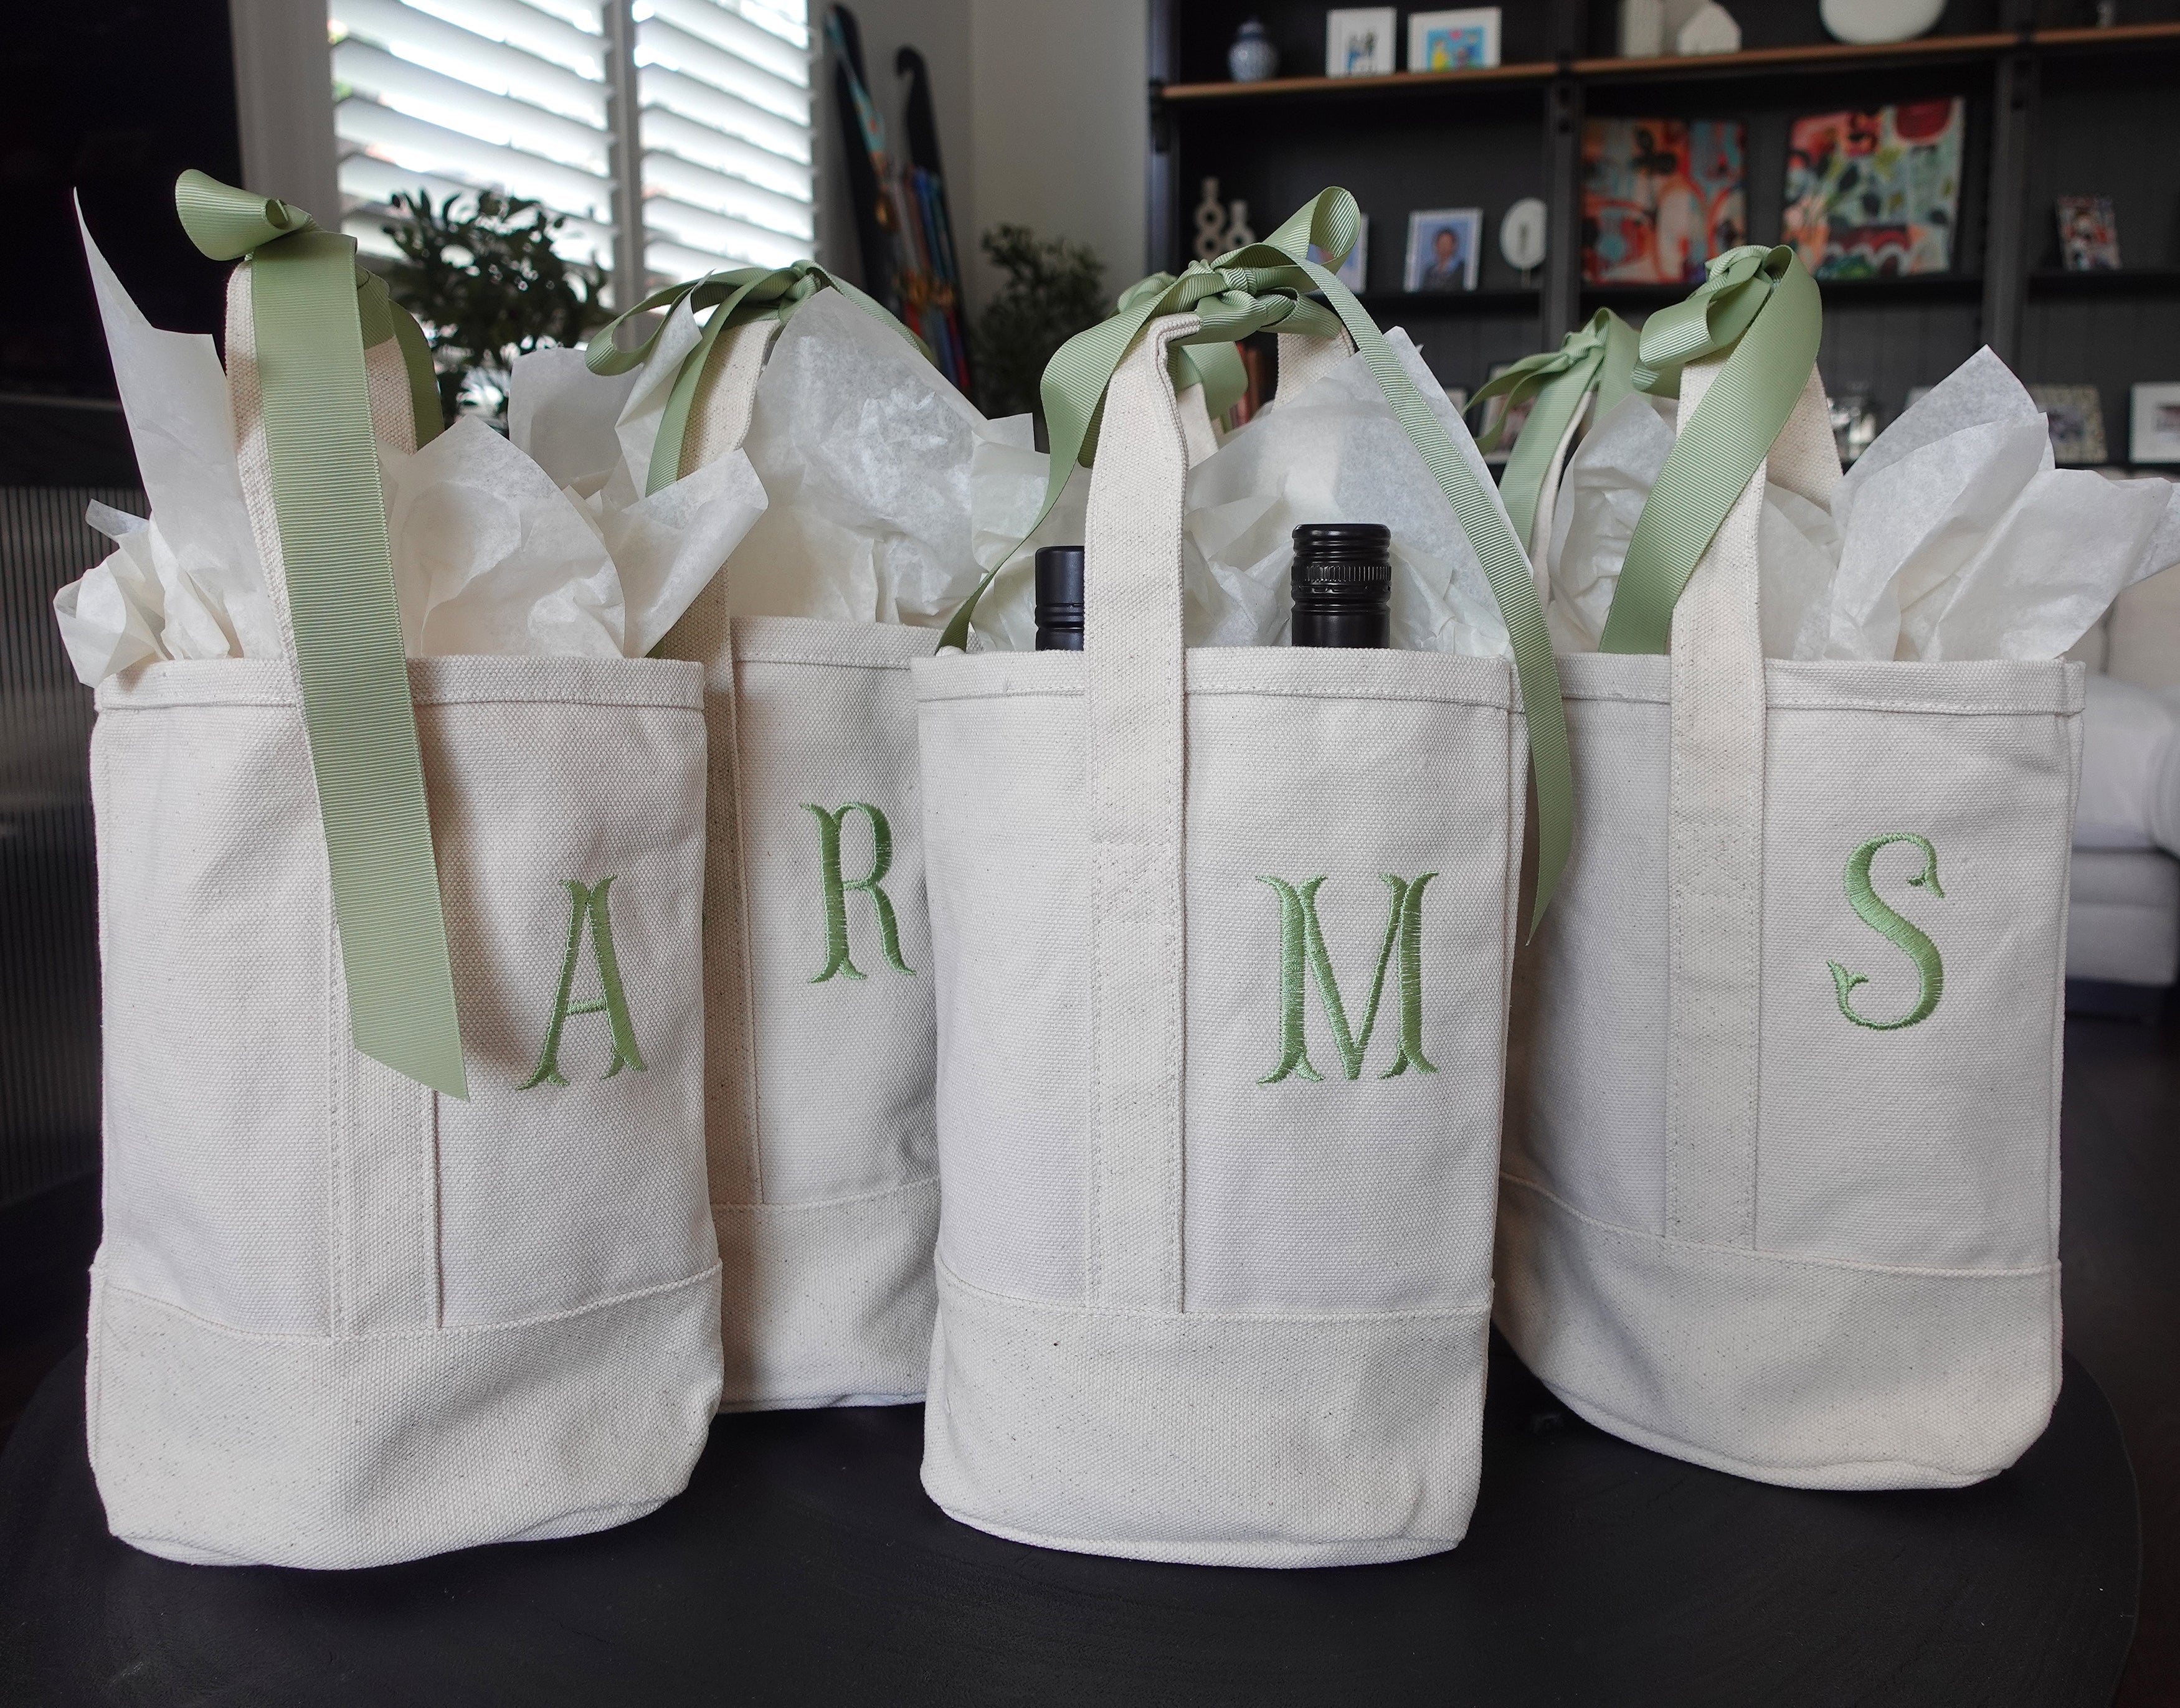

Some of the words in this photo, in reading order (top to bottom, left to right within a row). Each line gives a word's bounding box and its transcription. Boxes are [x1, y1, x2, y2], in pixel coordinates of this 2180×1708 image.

[517, 875, 648, 1091] A
[799, 801, 917, 984] R
[1256, 872, 1439, 1085] M
[1826, 833, 1944, 1031] S
